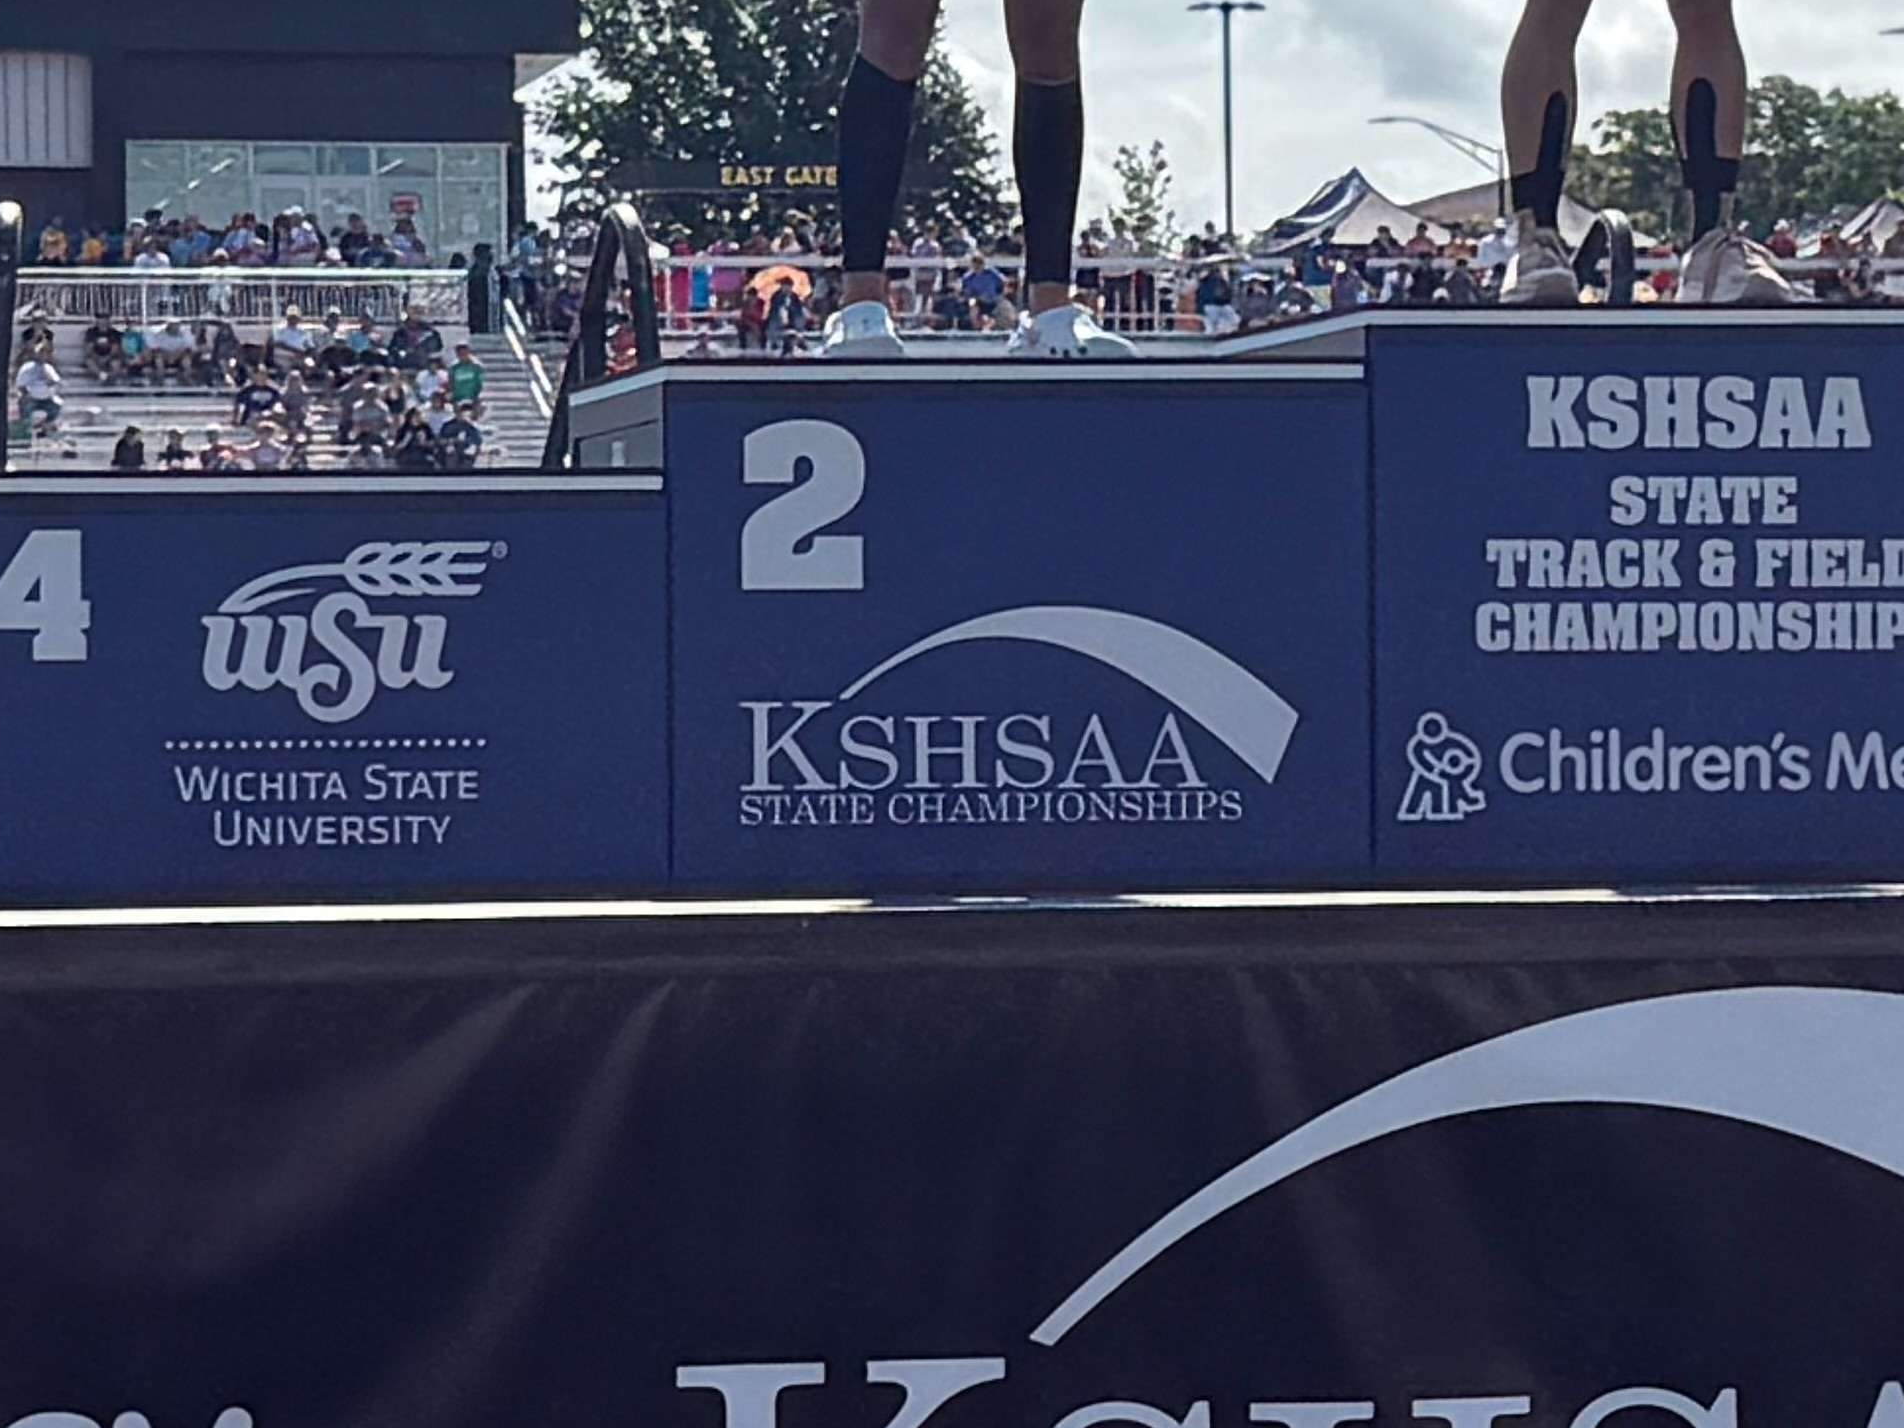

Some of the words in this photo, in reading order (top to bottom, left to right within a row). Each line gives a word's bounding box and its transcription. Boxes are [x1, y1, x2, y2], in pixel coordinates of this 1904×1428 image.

[720, 165, 774, 186] EAST
[1527, 376, 1871, 449] KSHSAA
[741, 419, 865, 590] 2
[1611, 476, 1797, 525] STATE
[1487, 539, 1681, 587] TRACK
[1700, 539, 1735, 587] &
[740, 701, 1208, 791] KSHSAA
[1500, 728, 1810, 792] Children's
[740, 794, 874, 826] STATE
[888, 790, 1243, 824] CHAMPIONSHIPS
